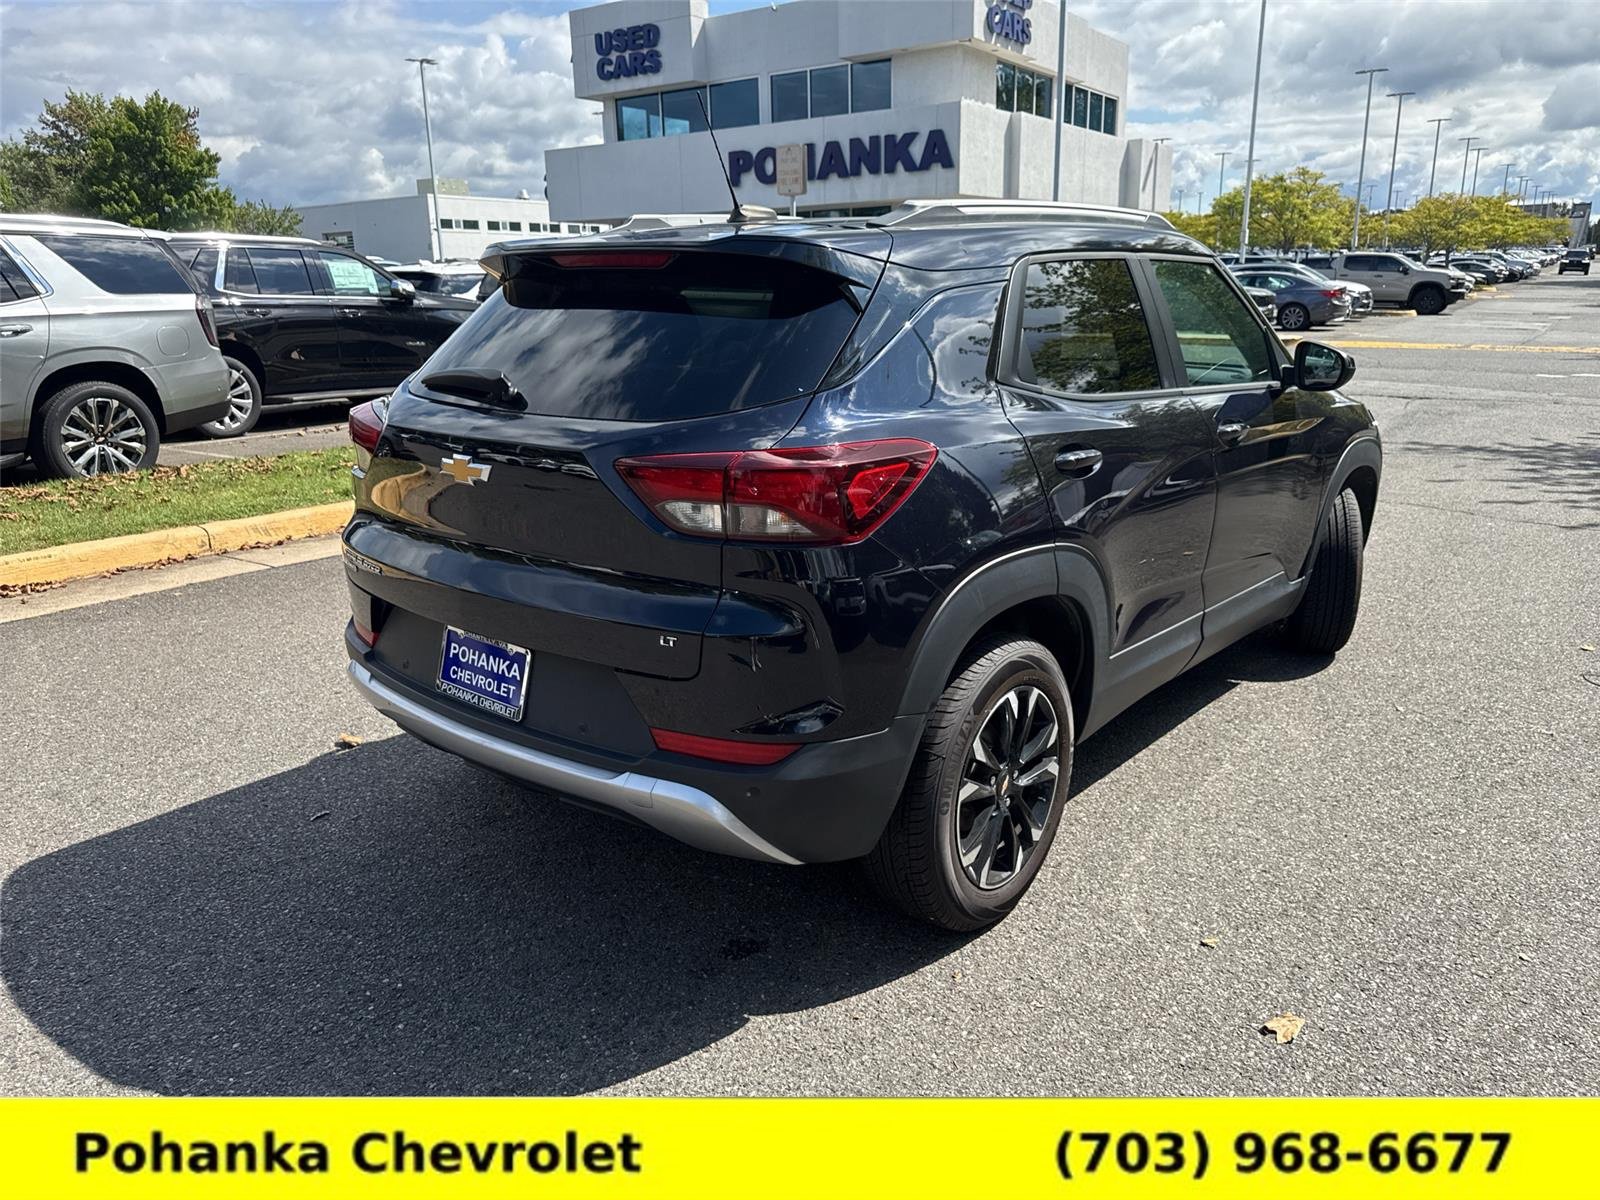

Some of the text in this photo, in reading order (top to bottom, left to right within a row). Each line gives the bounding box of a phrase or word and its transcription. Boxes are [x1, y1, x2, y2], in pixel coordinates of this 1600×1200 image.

[594, 23, 661, 57] USED
[986, 4, 1032, 45] CARS
[596, 49, 663, 81] CARS
[728, 129, 954, 187] POANKA
[659, 635, 677, 647] LT
[449, 642, 521, 681] POHANKA
[450, 665, 516, 699] CHEVROLET
[441, 682, 515, 718] POHANKA CHEVROLET
